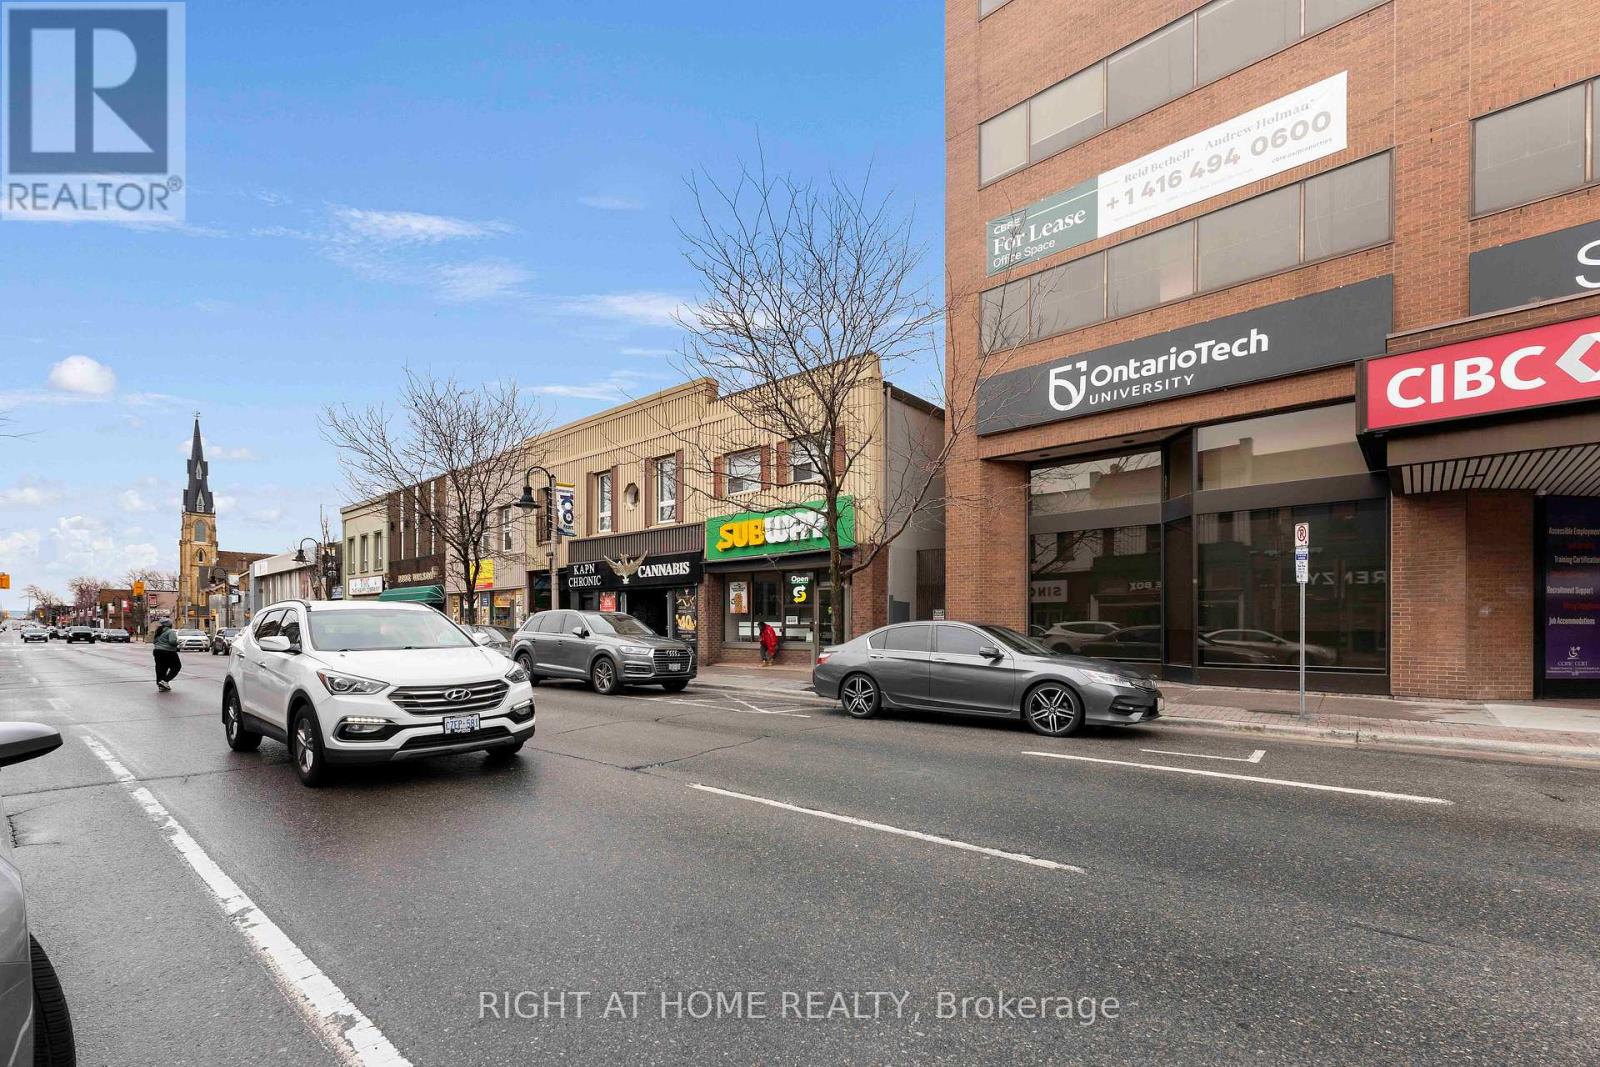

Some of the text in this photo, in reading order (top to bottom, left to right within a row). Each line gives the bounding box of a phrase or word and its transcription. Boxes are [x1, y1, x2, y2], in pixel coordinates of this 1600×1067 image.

[1140, 169, 1183, 198] 416
[1189, 147, 1241, 179] 494
[1250, 111, 1332, 156] 0600
[993, 209, 1088, 256] For Lease
[1024, 239, 1056, 257] Space
[1386, 345, 1547, 409] CIBC
[1089, 373, 1195, 405] UNIVERSITY
[573, 562, 596, 576] KAPN
[637, 561, 690, 578] CANNABIS
[568, 575, 602, 588] CHRONIC
[790, 575, 809, 583] Open
